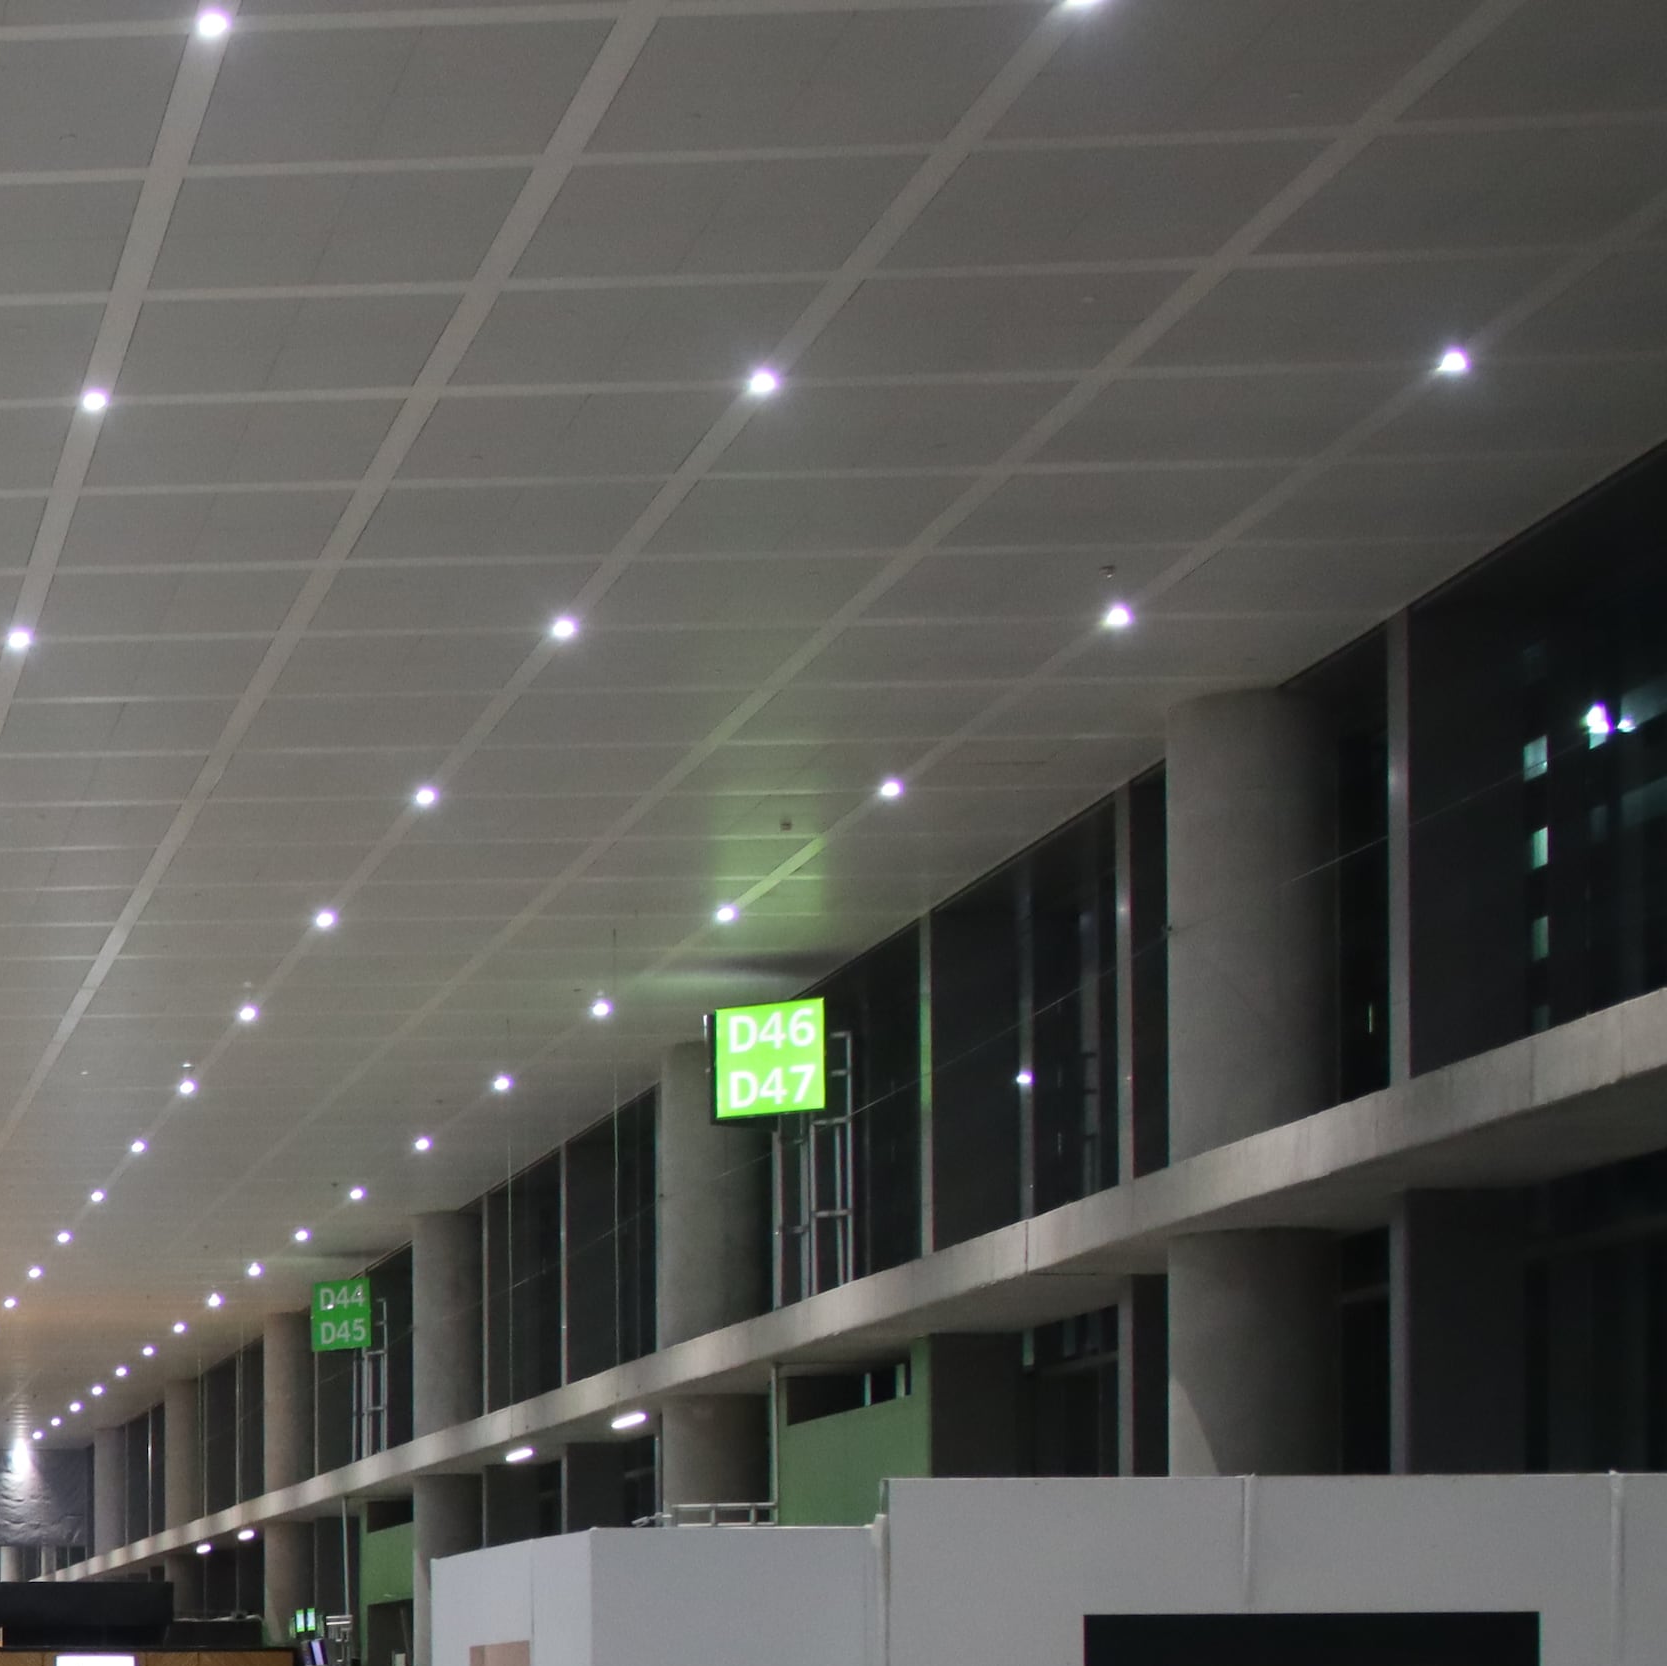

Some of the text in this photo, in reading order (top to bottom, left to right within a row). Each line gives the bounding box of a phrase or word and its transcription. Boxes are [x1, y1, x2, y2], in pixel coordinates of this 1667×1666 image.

[728, 1007, 816, 1054] D46
[728, 1063, 816, 1110] D47
[320, 1284, 365, 1311] D44
[321, 1318, 367, 1345] D45
